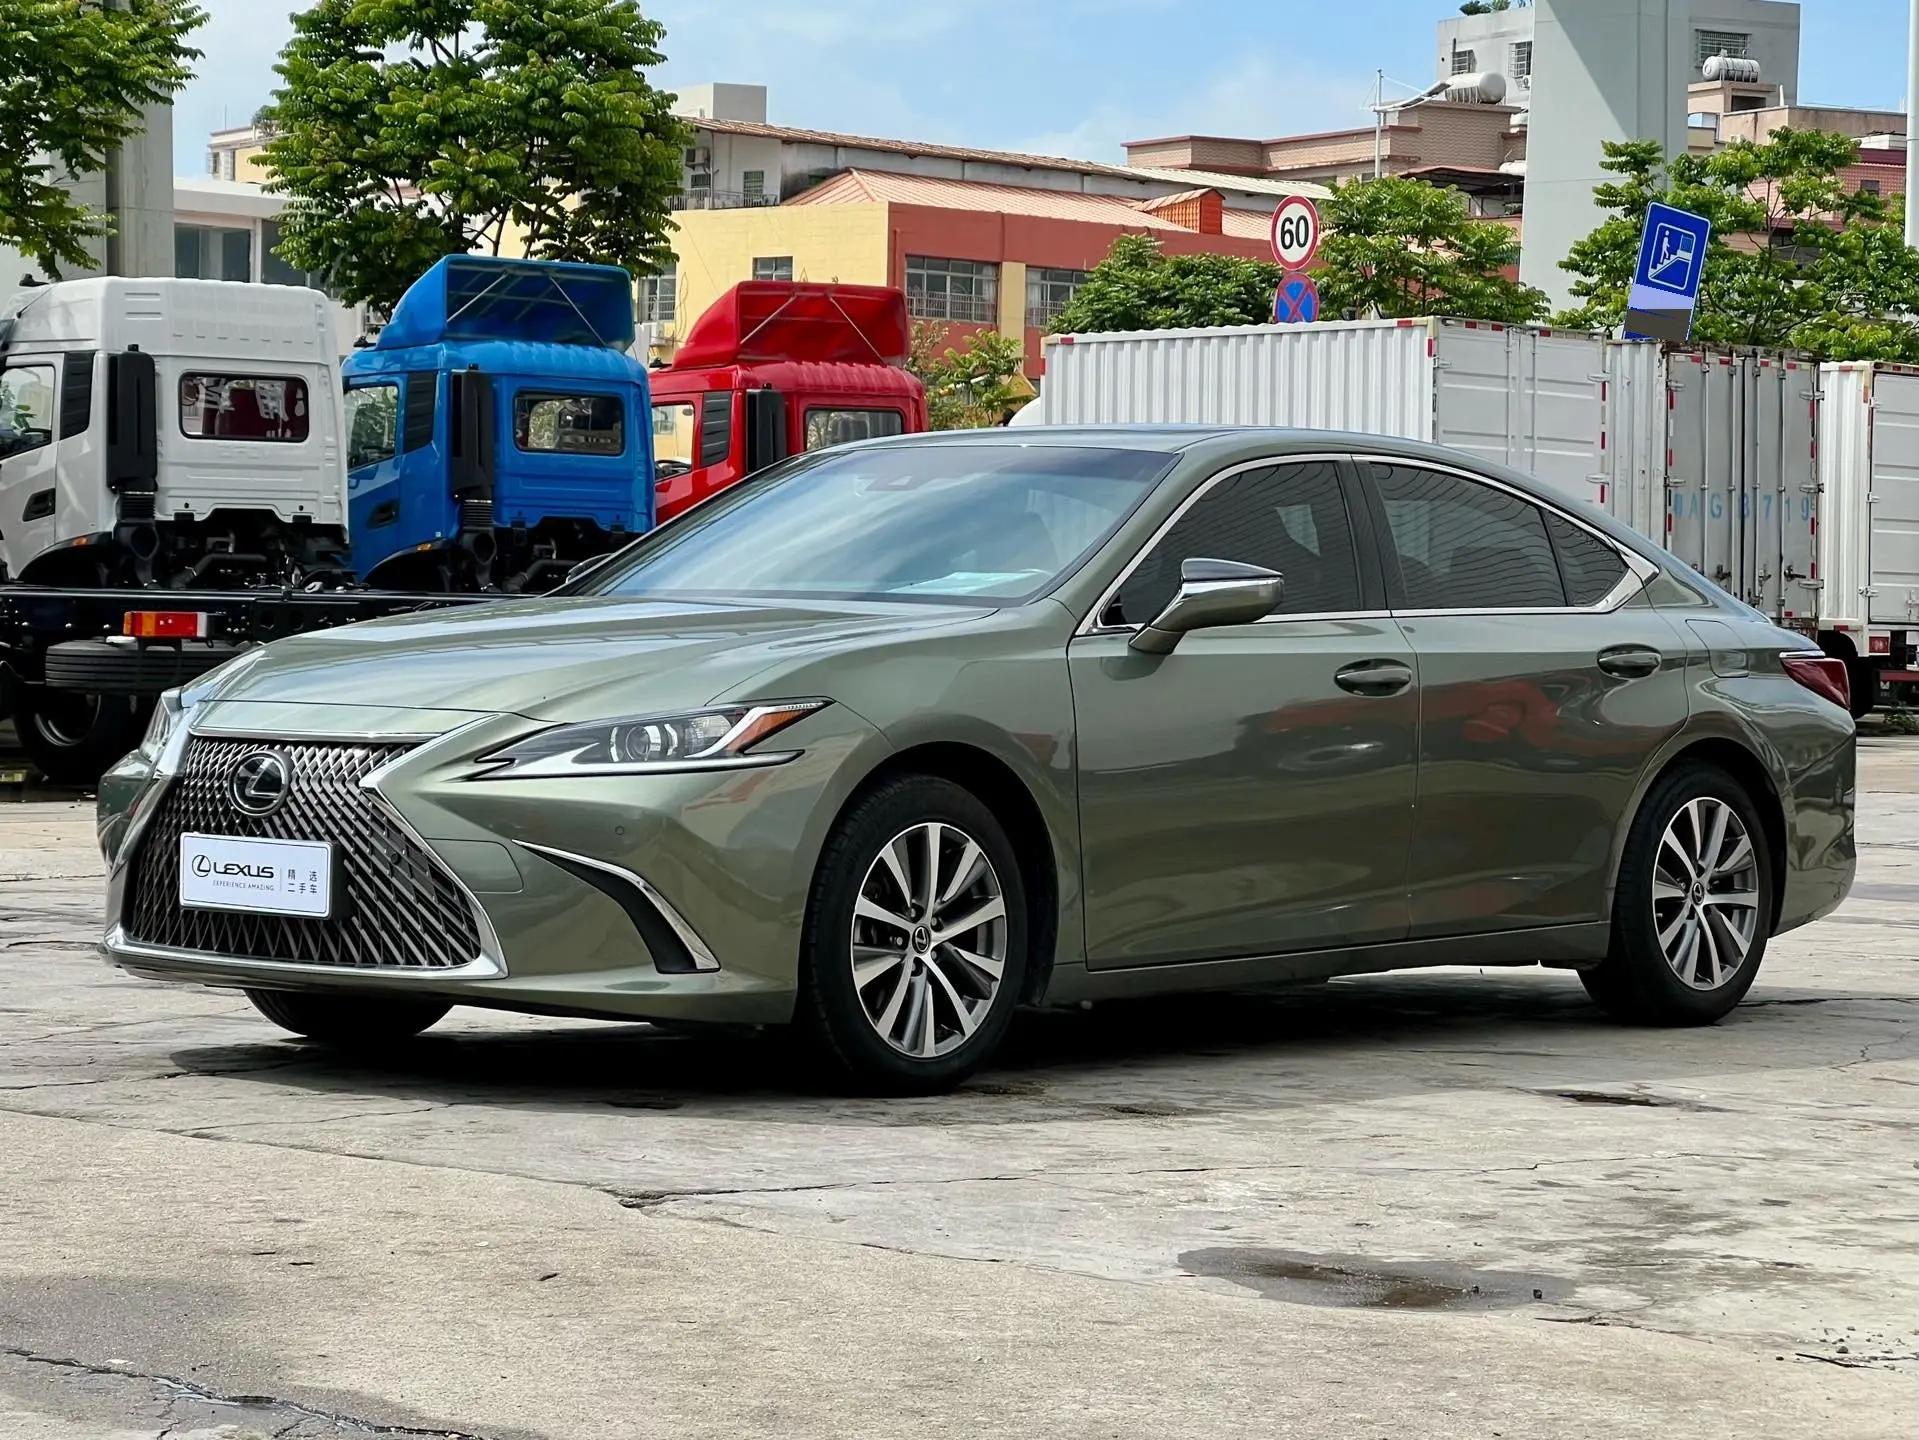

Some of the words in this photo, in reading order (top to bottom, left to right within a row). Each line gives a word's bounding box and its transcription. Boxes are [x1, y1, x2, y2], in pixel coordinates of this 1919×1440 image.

[1280, 215, 1310, 250] 60
[213, 862, 275, 879] LEXUS
[213, 879, 246, 889] EXPERIENCE
[247, 883, 275, 892] AMAZING
